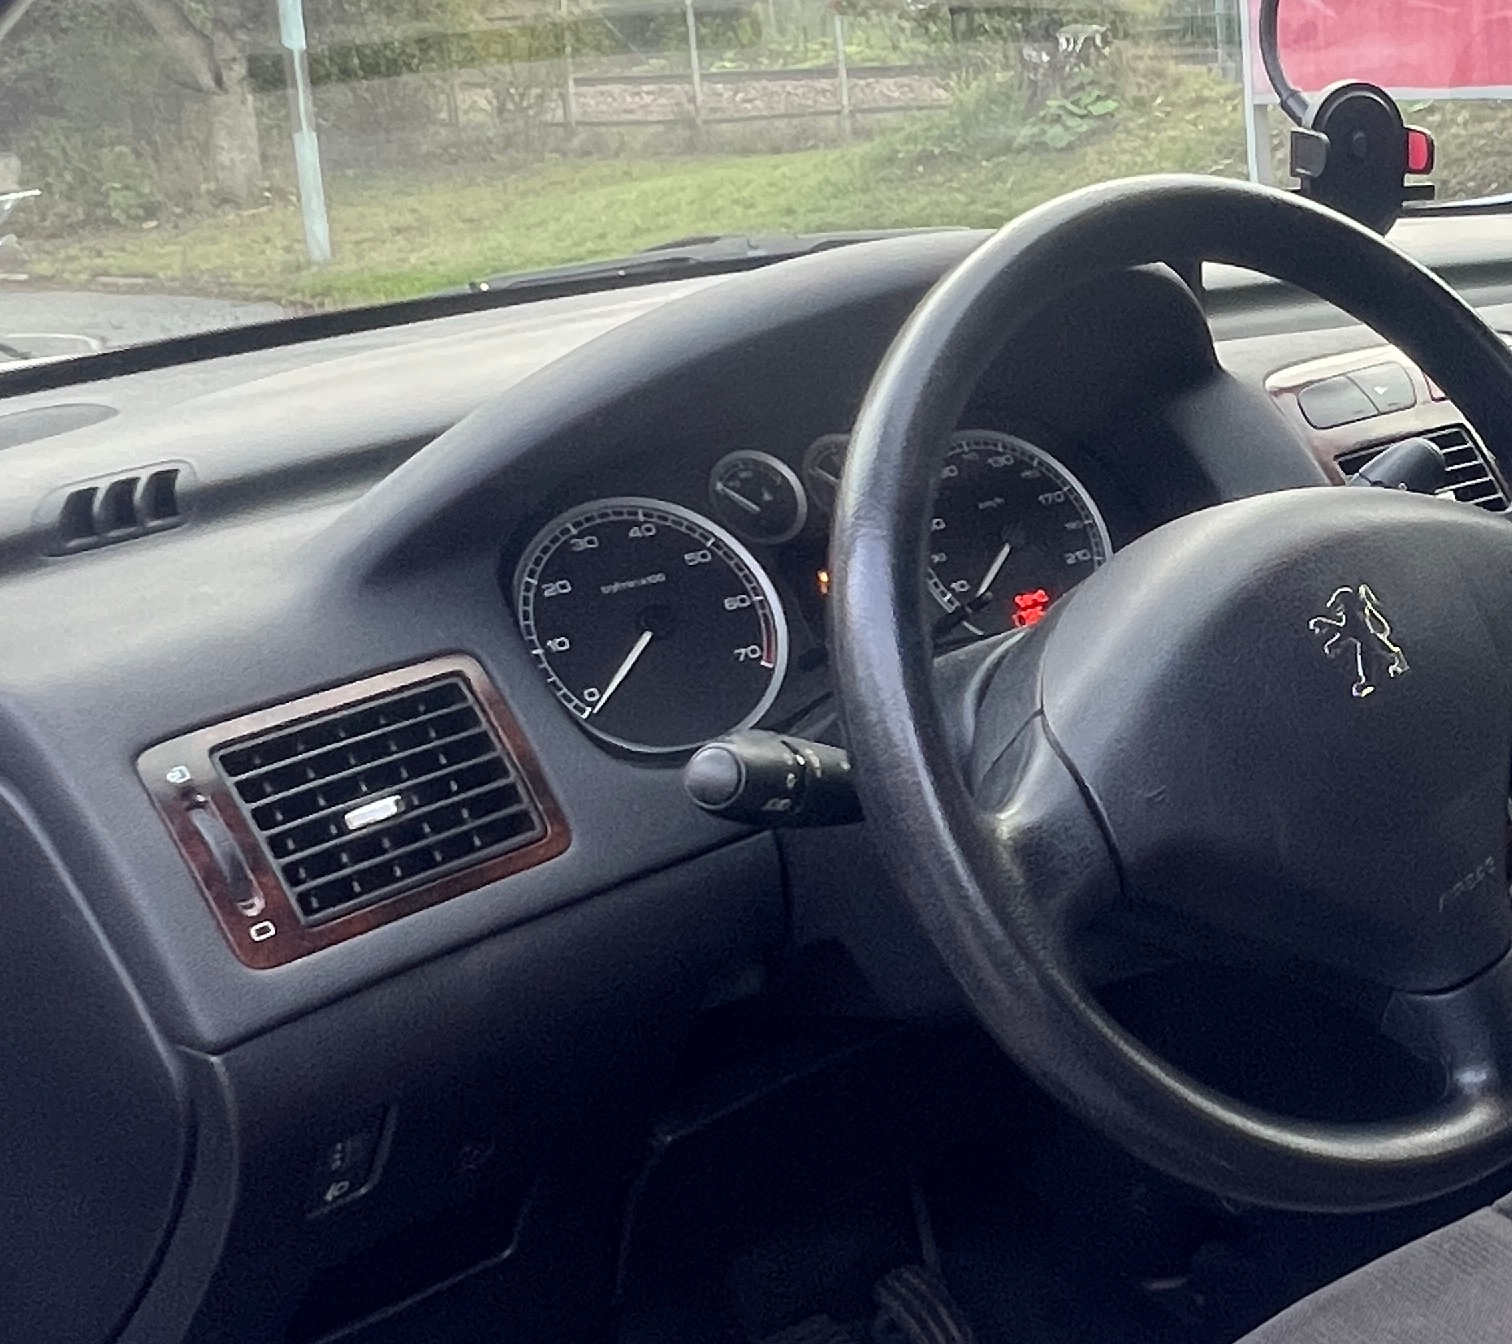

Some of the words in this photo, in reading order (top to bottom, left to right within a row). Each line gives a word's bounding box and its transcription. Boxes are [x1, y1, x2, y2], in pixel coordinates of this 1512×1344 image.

[629, 523, 656, 538] 40
[570, 536, 599, 551] 30
[684, 550, 712, 566] 50
[541, 580, 572, 597] 20
[724, 594, 751, 611] 60
[546, 637, 570, 652] 10
[733, 645, 761, 661] 70
[584, 687, 600, 701] 0
